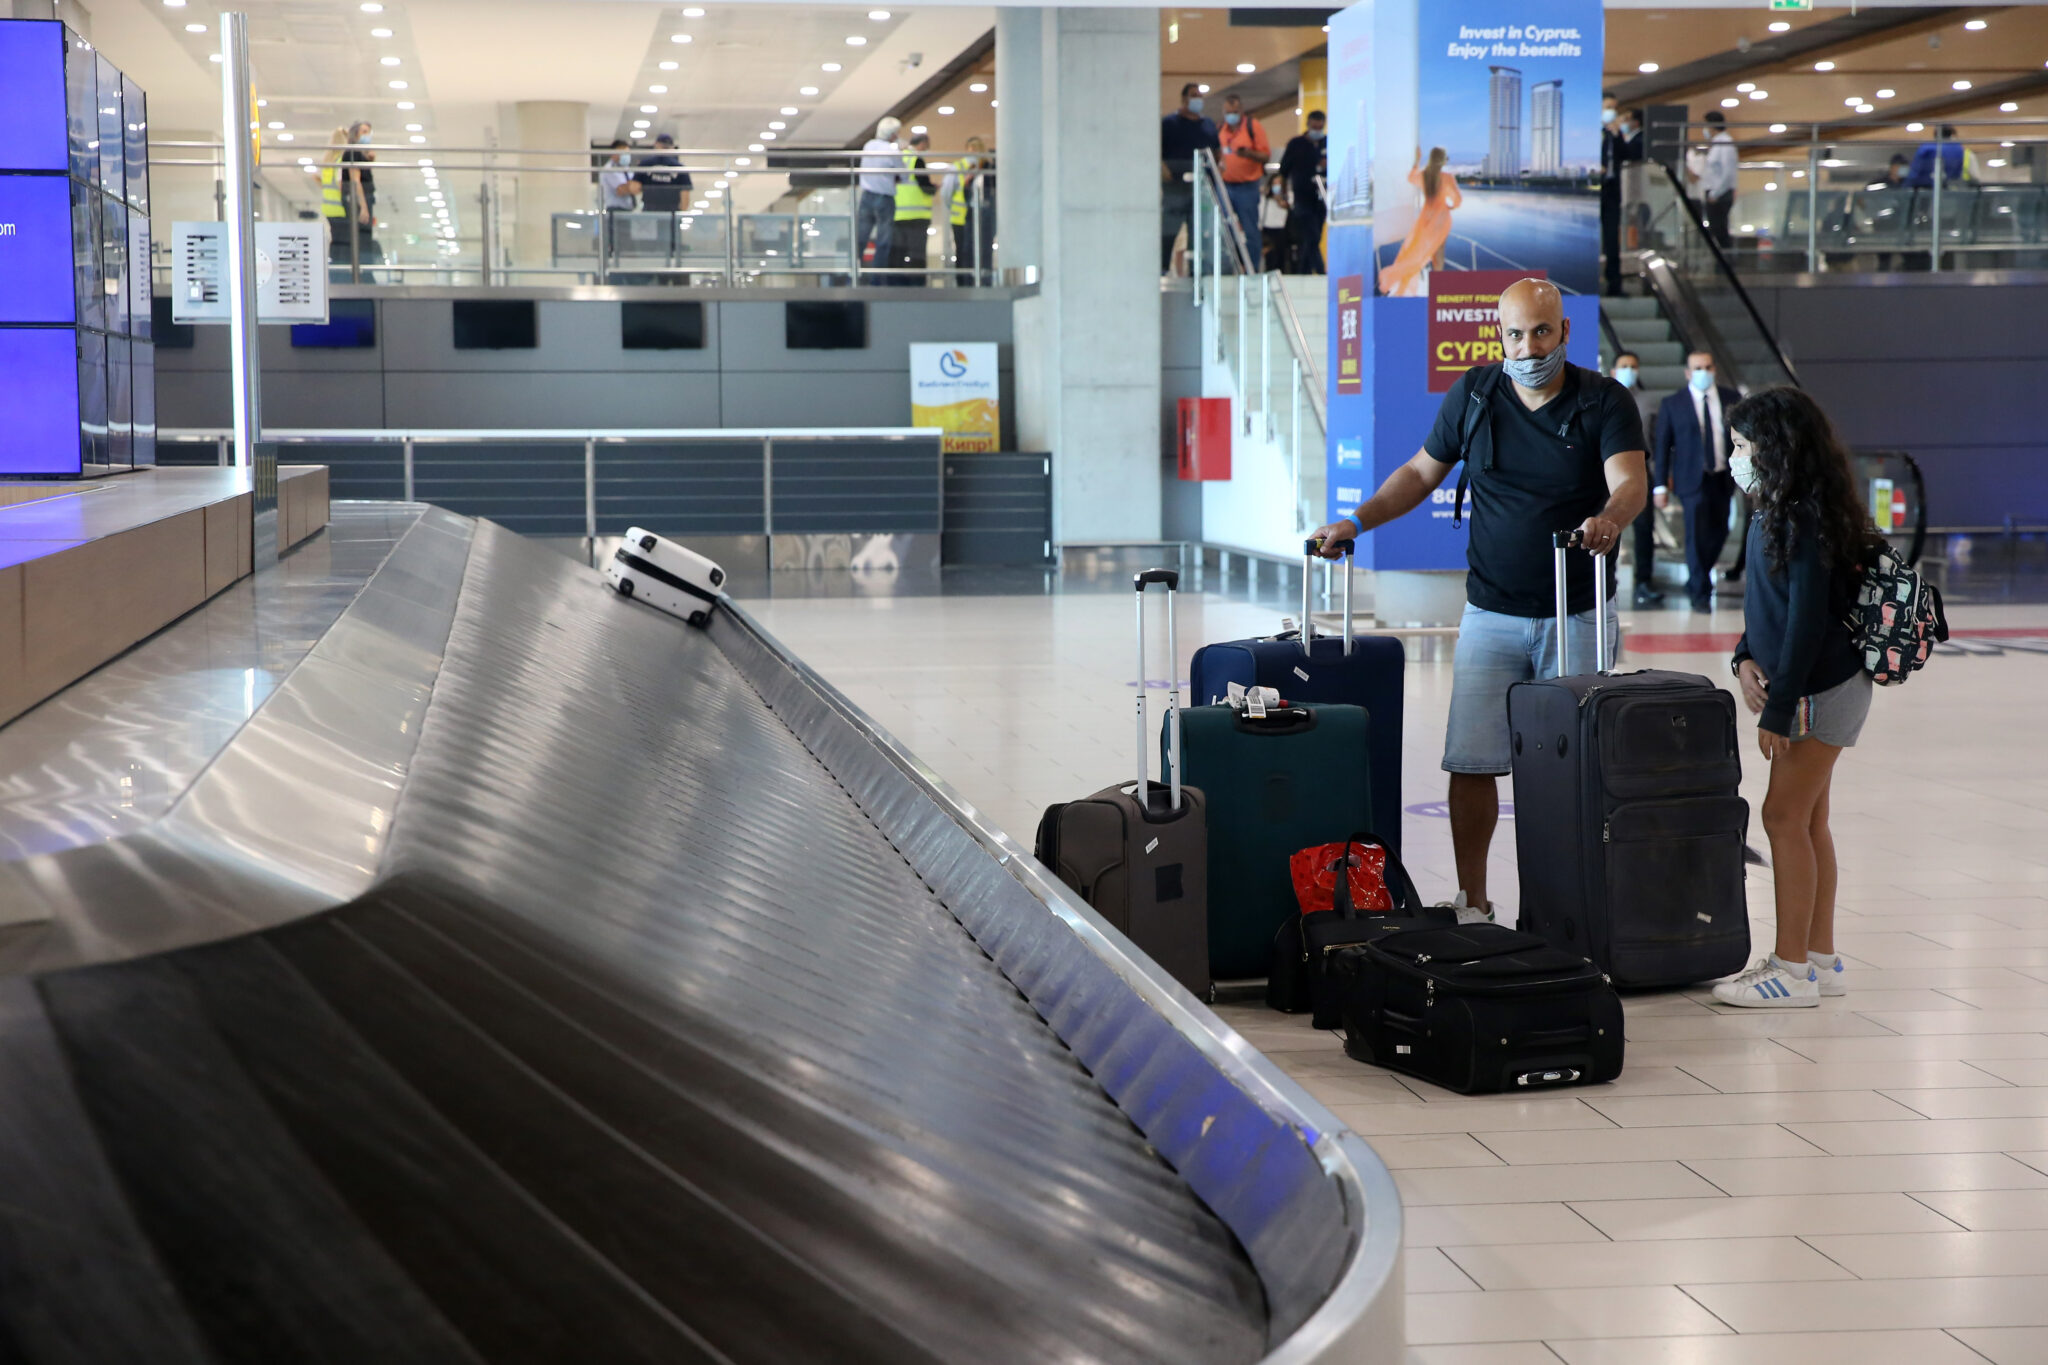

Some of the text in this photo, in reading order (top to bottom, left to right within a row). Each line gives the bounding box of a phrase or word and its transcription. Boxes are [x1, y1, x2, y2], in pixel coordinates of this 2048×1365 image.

[1459, 25, 1581, 42] Invest in Cyprus.
[1447, 42, 1582, 60] Enjoy the benefits
[1436, 294, 1473, 304] BENEFIT
[1478, 325, 1497, 339] IN
